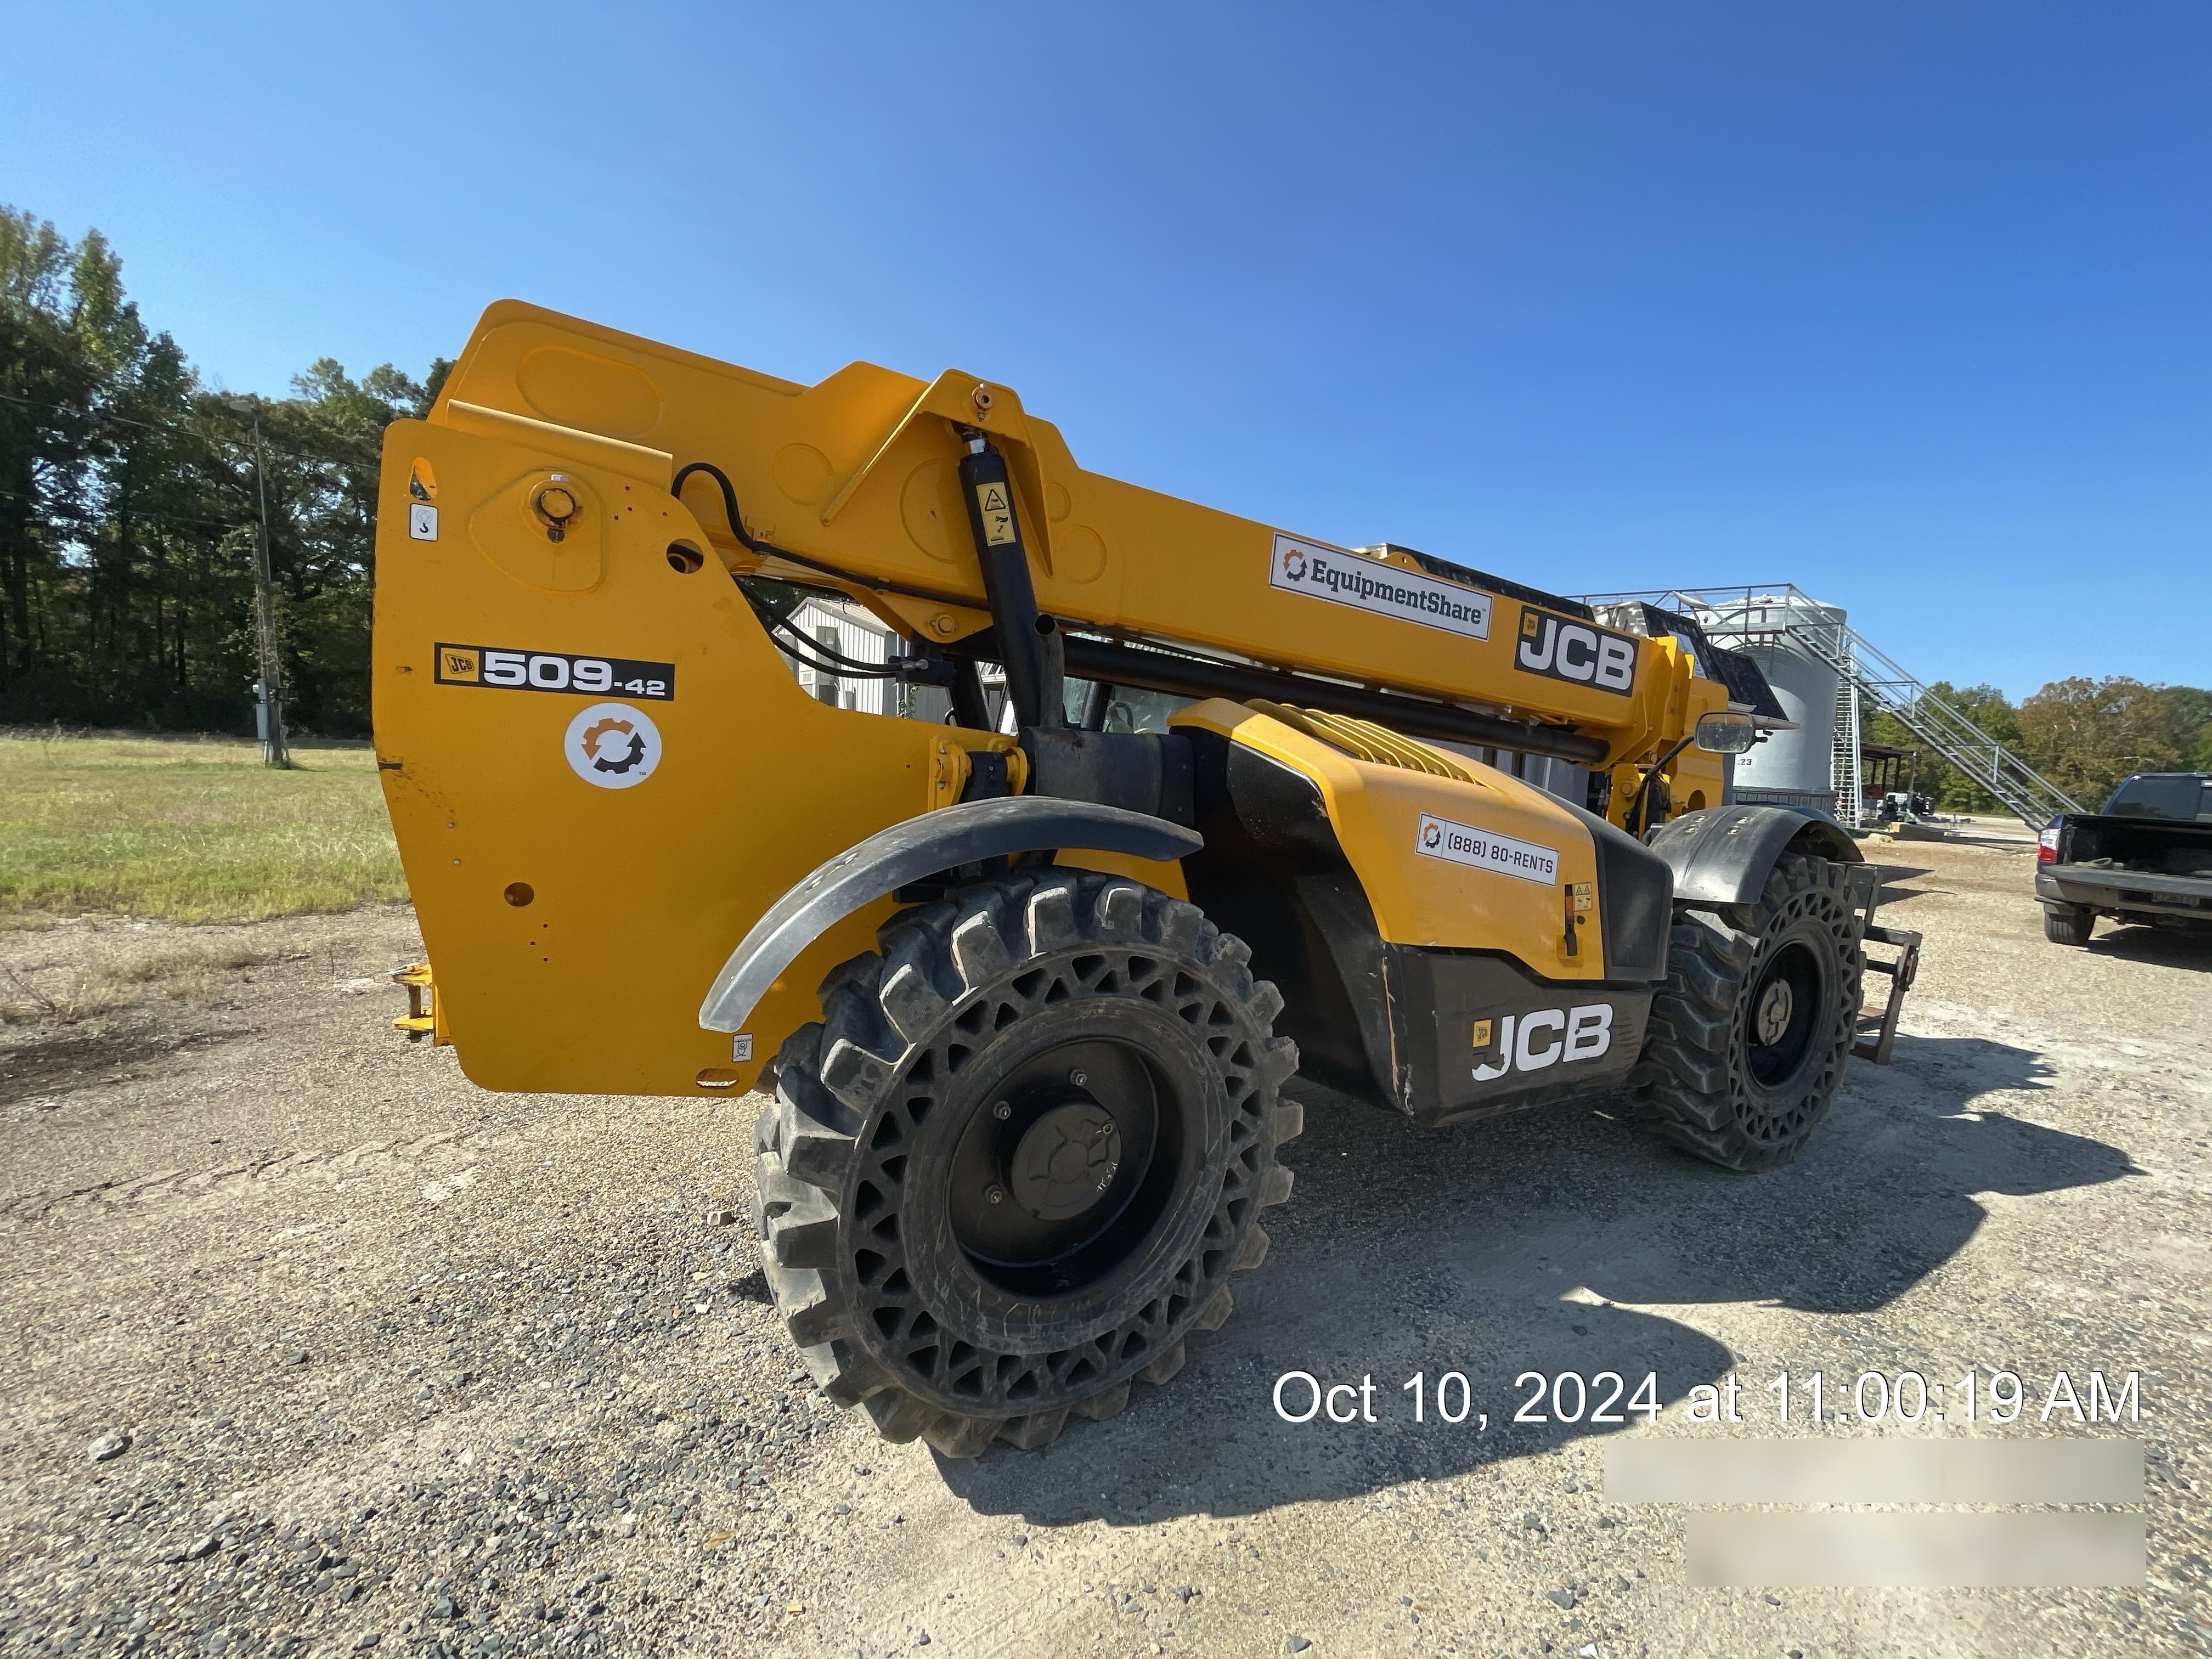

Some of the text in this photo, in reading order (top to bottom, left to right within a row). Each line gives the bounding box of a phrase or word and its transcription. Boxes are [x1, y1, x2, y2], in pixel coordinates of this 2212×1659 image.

[1310, 558, 1482, 625] EquipmentShare
[450, 656, 473, 672] JCB
[483, 651, 665, 697] 509-42
[1520, 618, 1634, 690] JCB
[1447, 832, 1554, 874] (888) 80-RENTS
[1471, 1003, 1613, 1082] JCB
